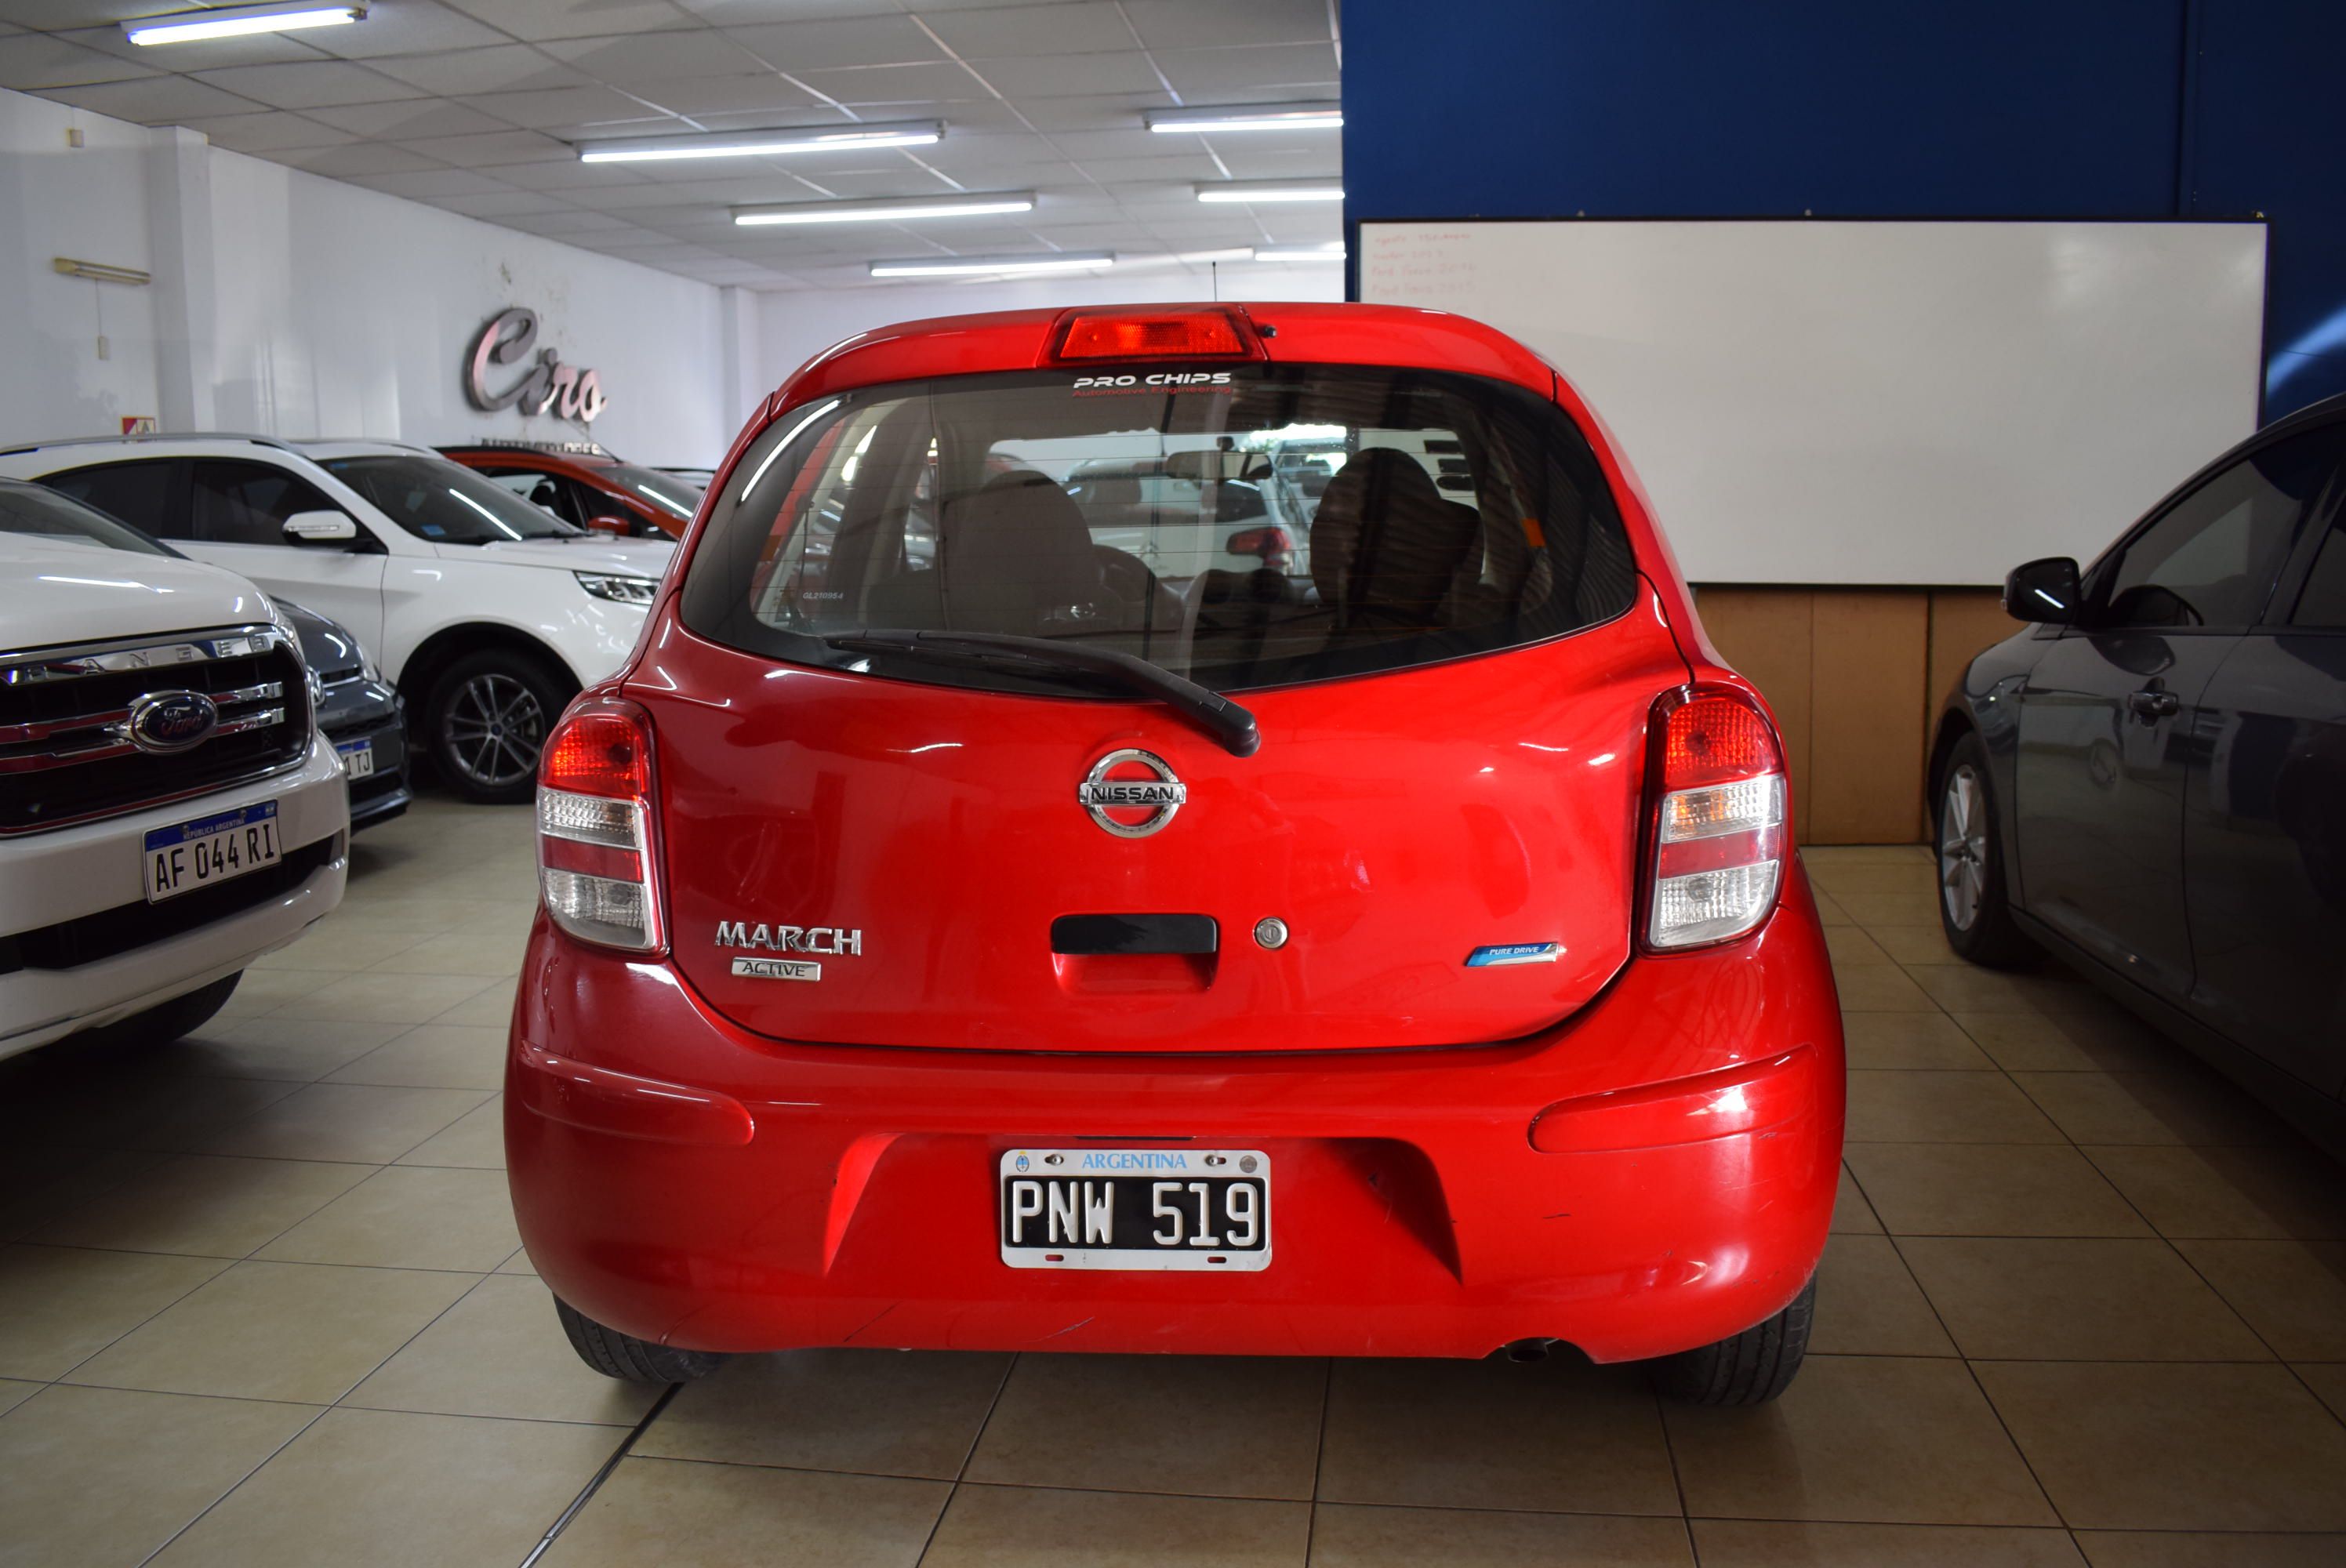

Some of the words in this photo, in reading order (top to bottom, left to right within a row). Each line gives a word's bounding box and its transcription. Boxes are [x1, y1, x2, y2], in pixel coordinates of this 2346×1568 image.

[467, 307, 607, 423] Ciro
[1073, 376, 1136, 389] PRO
[1145, 373, 1231, 385] CHIPS
[1073, 388, 1146, 397] Automotive
[1151, 385, 1231, 395] Engineering
[162, 706, 205, 736] Ford
[1091, 786, 1174, 800] NISSAN
[157, 848, 184, 892] AF
[194, 834, 239, 880] 044
[246, 824, 274, 864] RI
[714, 920, 862, 956] MARCH
[1490, 947, 1513, 956] PURE
[742, 961, 805, 977] ACTIVE
[1081, 1152, 1187, 1170] ARGENTINA
[1012, 1180, 1114, 1243] PNW
[1153, 1181, 1258, 1246] 519
